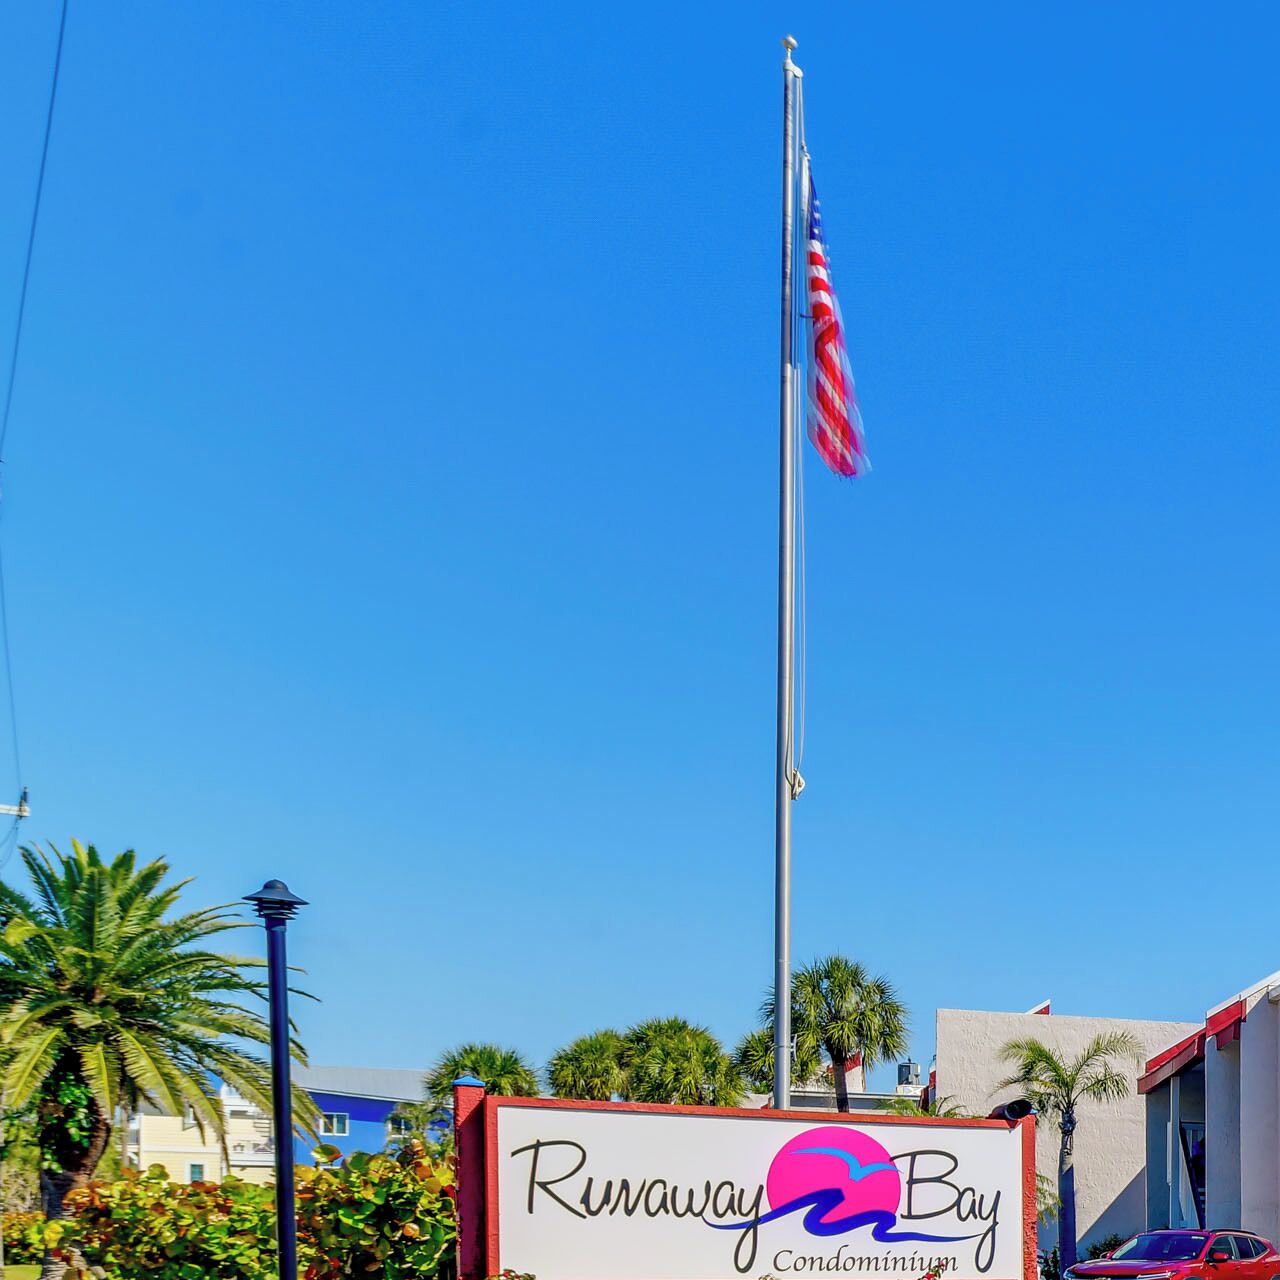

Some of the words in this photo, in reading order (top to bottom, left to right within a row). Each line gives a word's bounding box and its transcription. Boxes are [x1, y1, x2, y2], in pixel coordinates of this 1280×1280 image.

[511, 1138, 764, 1274] Runaway
[889, 1149, 1002, 1274] Bay
[773, 1244, 959, 1272] Condominium
